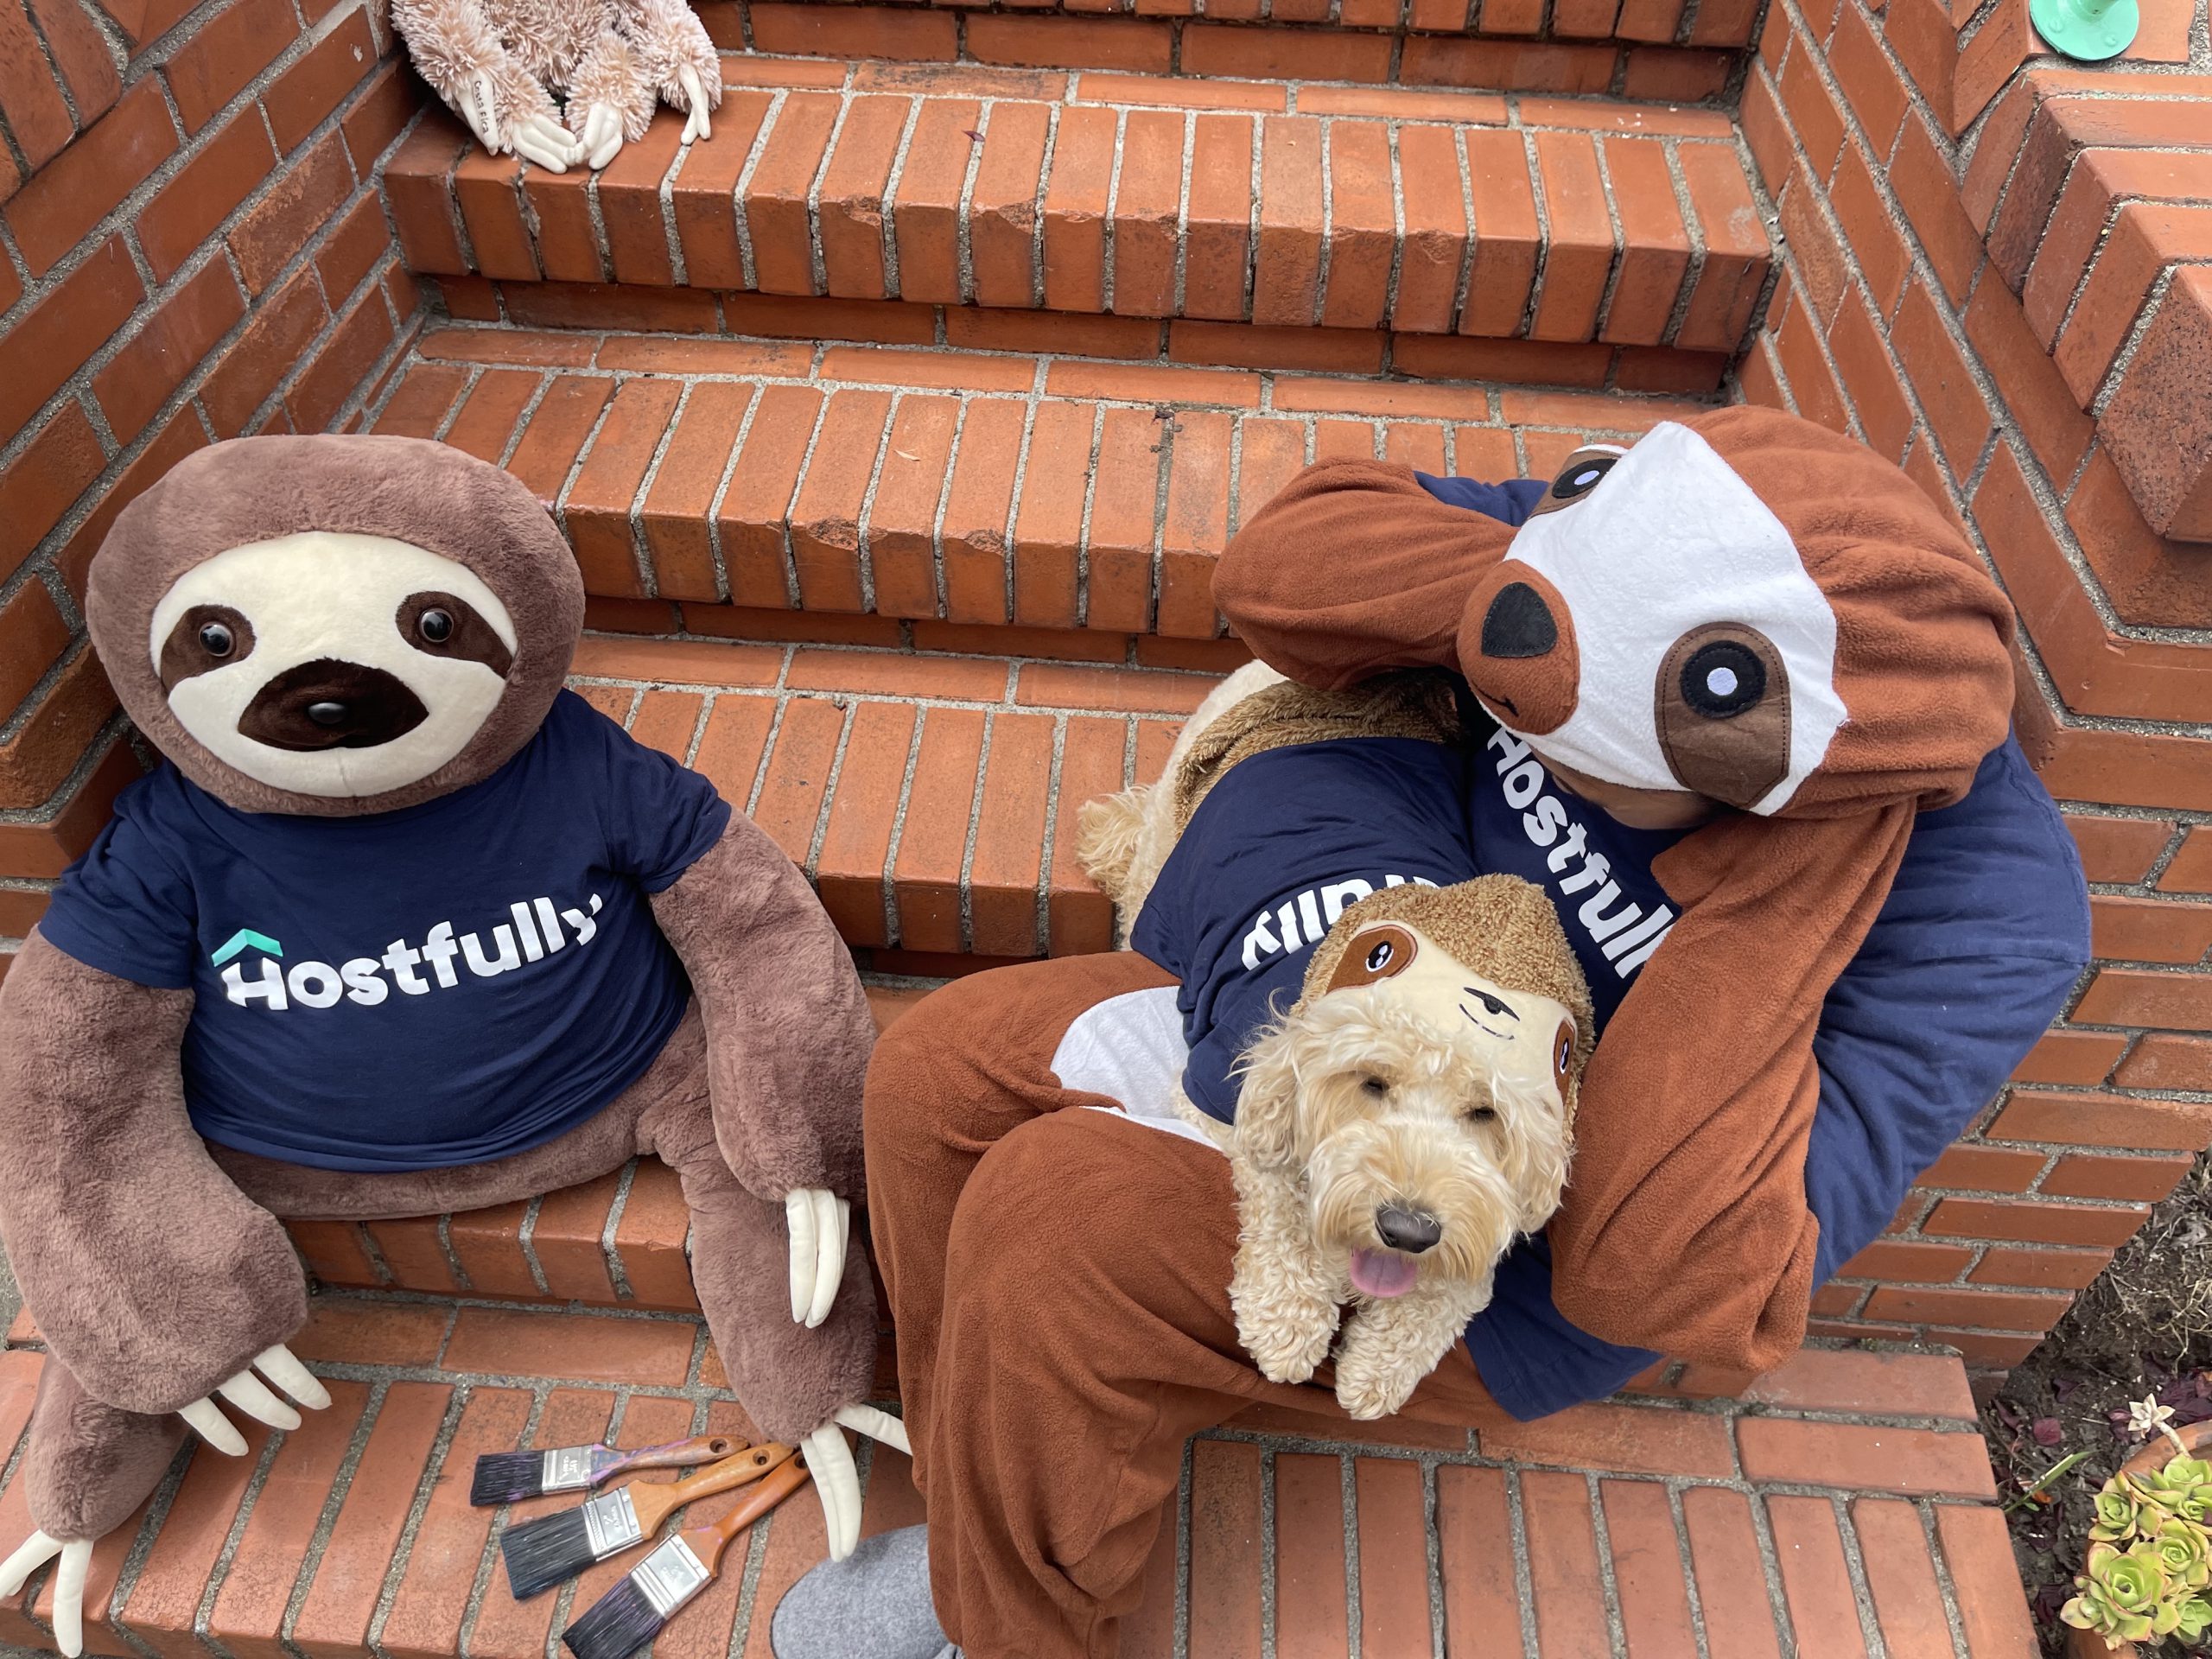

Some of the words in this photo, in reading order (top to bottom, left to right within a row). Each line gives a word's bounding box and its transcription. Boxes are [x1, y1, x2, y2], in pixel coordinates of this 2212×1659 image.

[474, 80, 484, 109] Costa
[1487, 728, 1674, 979] Hostfull
[220, 893, 603, 1011] Hostfully
[1242, 874, 1440, 971] ully
